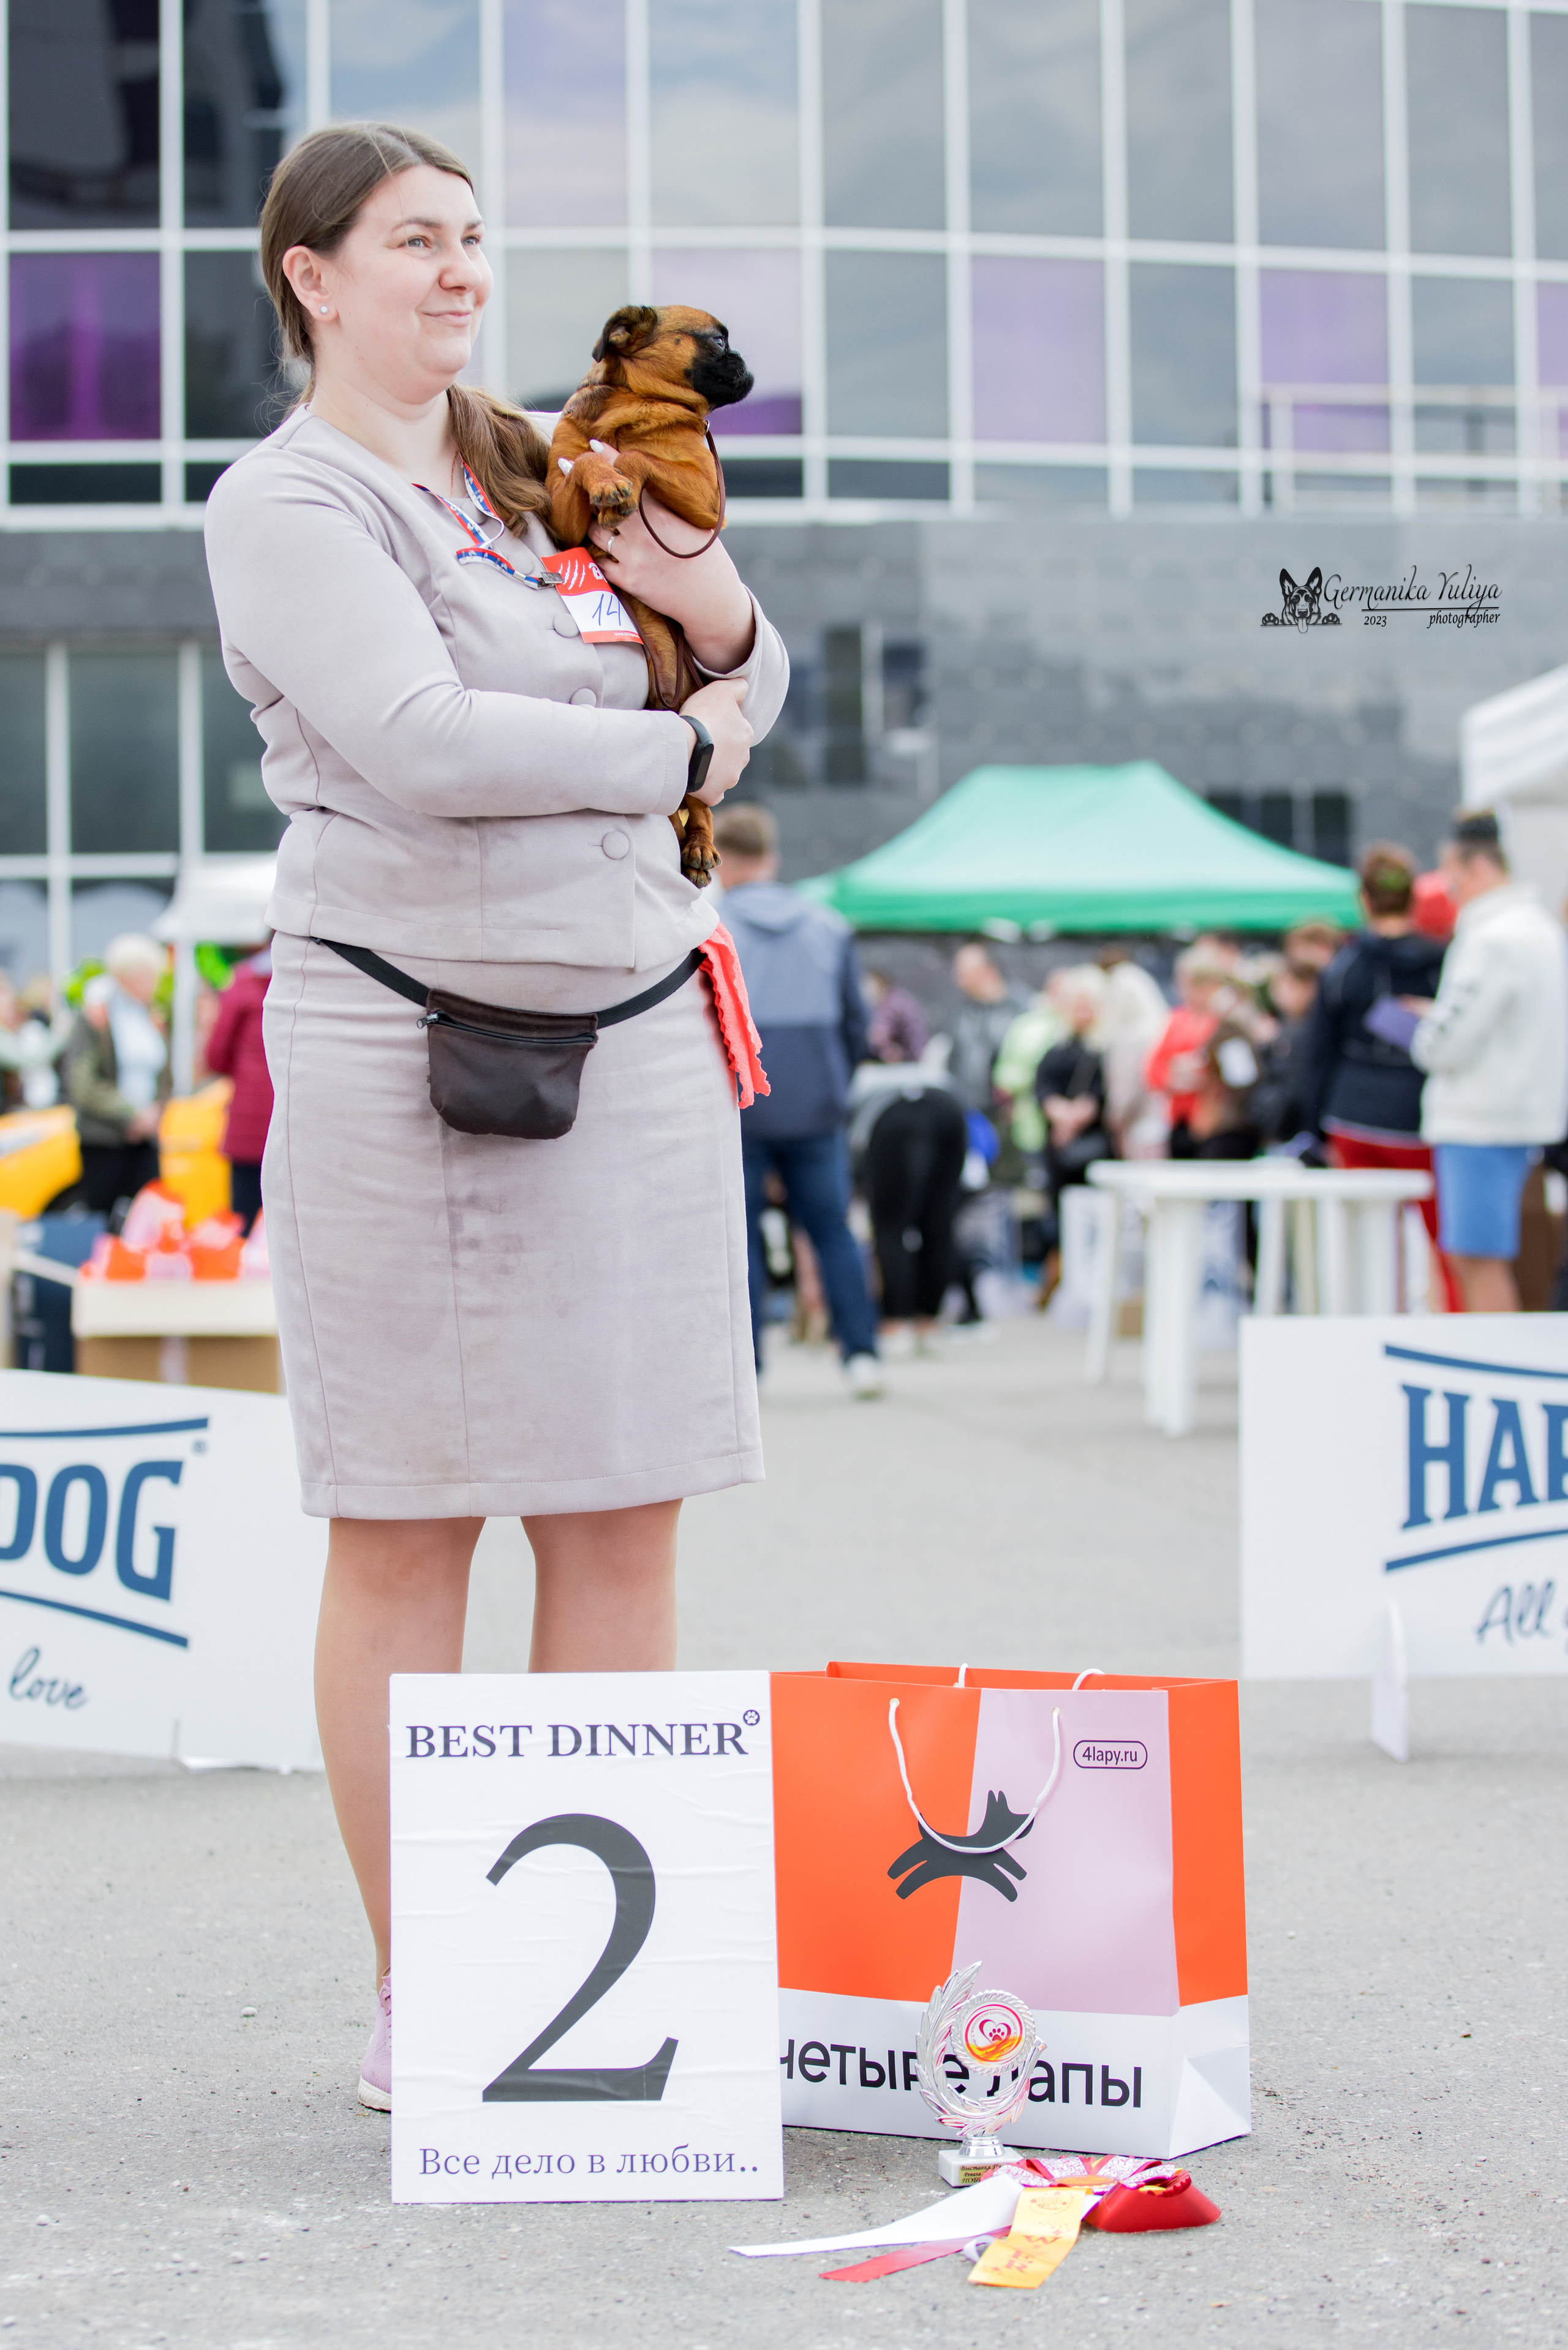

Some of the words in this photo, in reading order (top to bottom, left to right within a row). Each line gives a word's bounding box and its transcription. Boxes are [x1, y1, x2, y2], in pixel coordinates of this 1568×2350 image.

[592, 593, 622, 627] 14
[1475, 1579, 1556, 1645] All
[8, 1646, 88, 1709] love
[405, 1724, 533, 1758] BEST
[547, 1722, 748, 1757] DINNER
[1082, 1746, 1137, 1765] 4lapy.ru
[482, 1813, 679, 2103] 2
[419, 2149, 480, 2175] Все
[492, 2154, 575, 2180] дело
[587, 2155, 605, 2174] в
[616, 2143, 758, 2174] любви..
